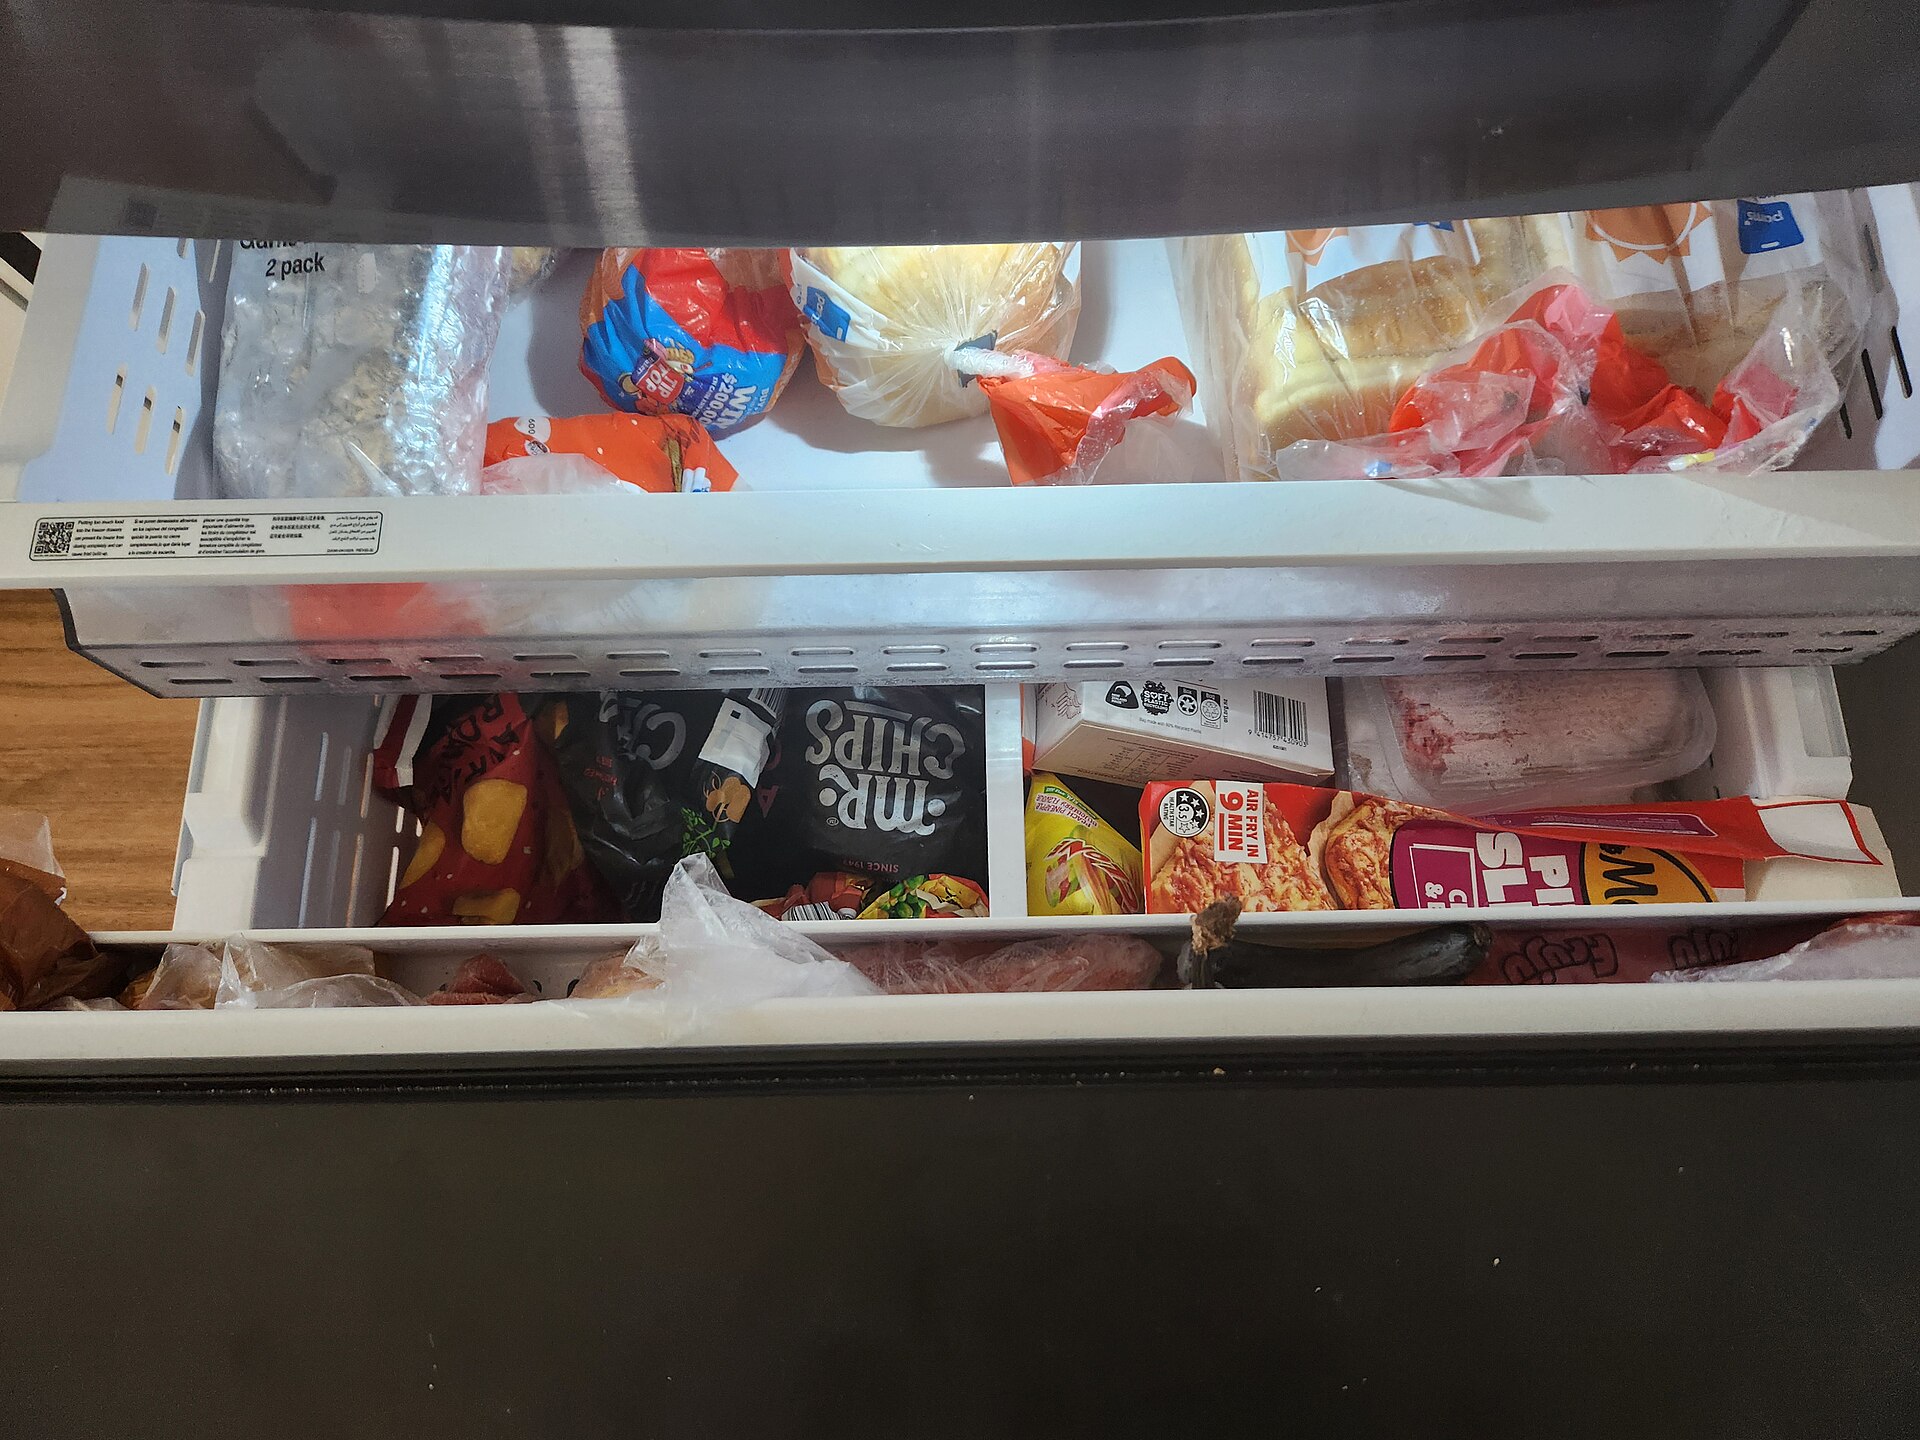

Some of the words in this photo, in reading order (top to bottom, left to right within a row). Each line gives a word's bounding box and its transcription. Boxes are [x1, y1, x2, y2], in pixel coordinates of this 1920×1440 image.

[265, 259, 277, 277] 2
[282, 252, 325, 280] pack
[643, 363, 670, 394] TOP
[655, 375, 677, 400] TIP
[700, 372, 738, 428] $200,00
[716, 386, 757, 429] WIN
[805, 700, 965, 780] CHIPS
[1036, 802, 1066, 814] PINEAPPLE
[1178, 806, 1190, 819] 3.5
[1220, 791, 1244, 811] 9
[1246, 789, 1259, 811] AIR
[1228, 814, 1244, 851] MIN
[1246, 816, 1259, 841] FRY
[1247, 844, 1259, 858] IN
[867, 862, 899, 873] SINCE
[1476, 832, 1534, 907] SL
[1529, 855, 1575, 906] PI
[1599, 853, 1658, 905] M
[1449, 888, 1467, 908] C
